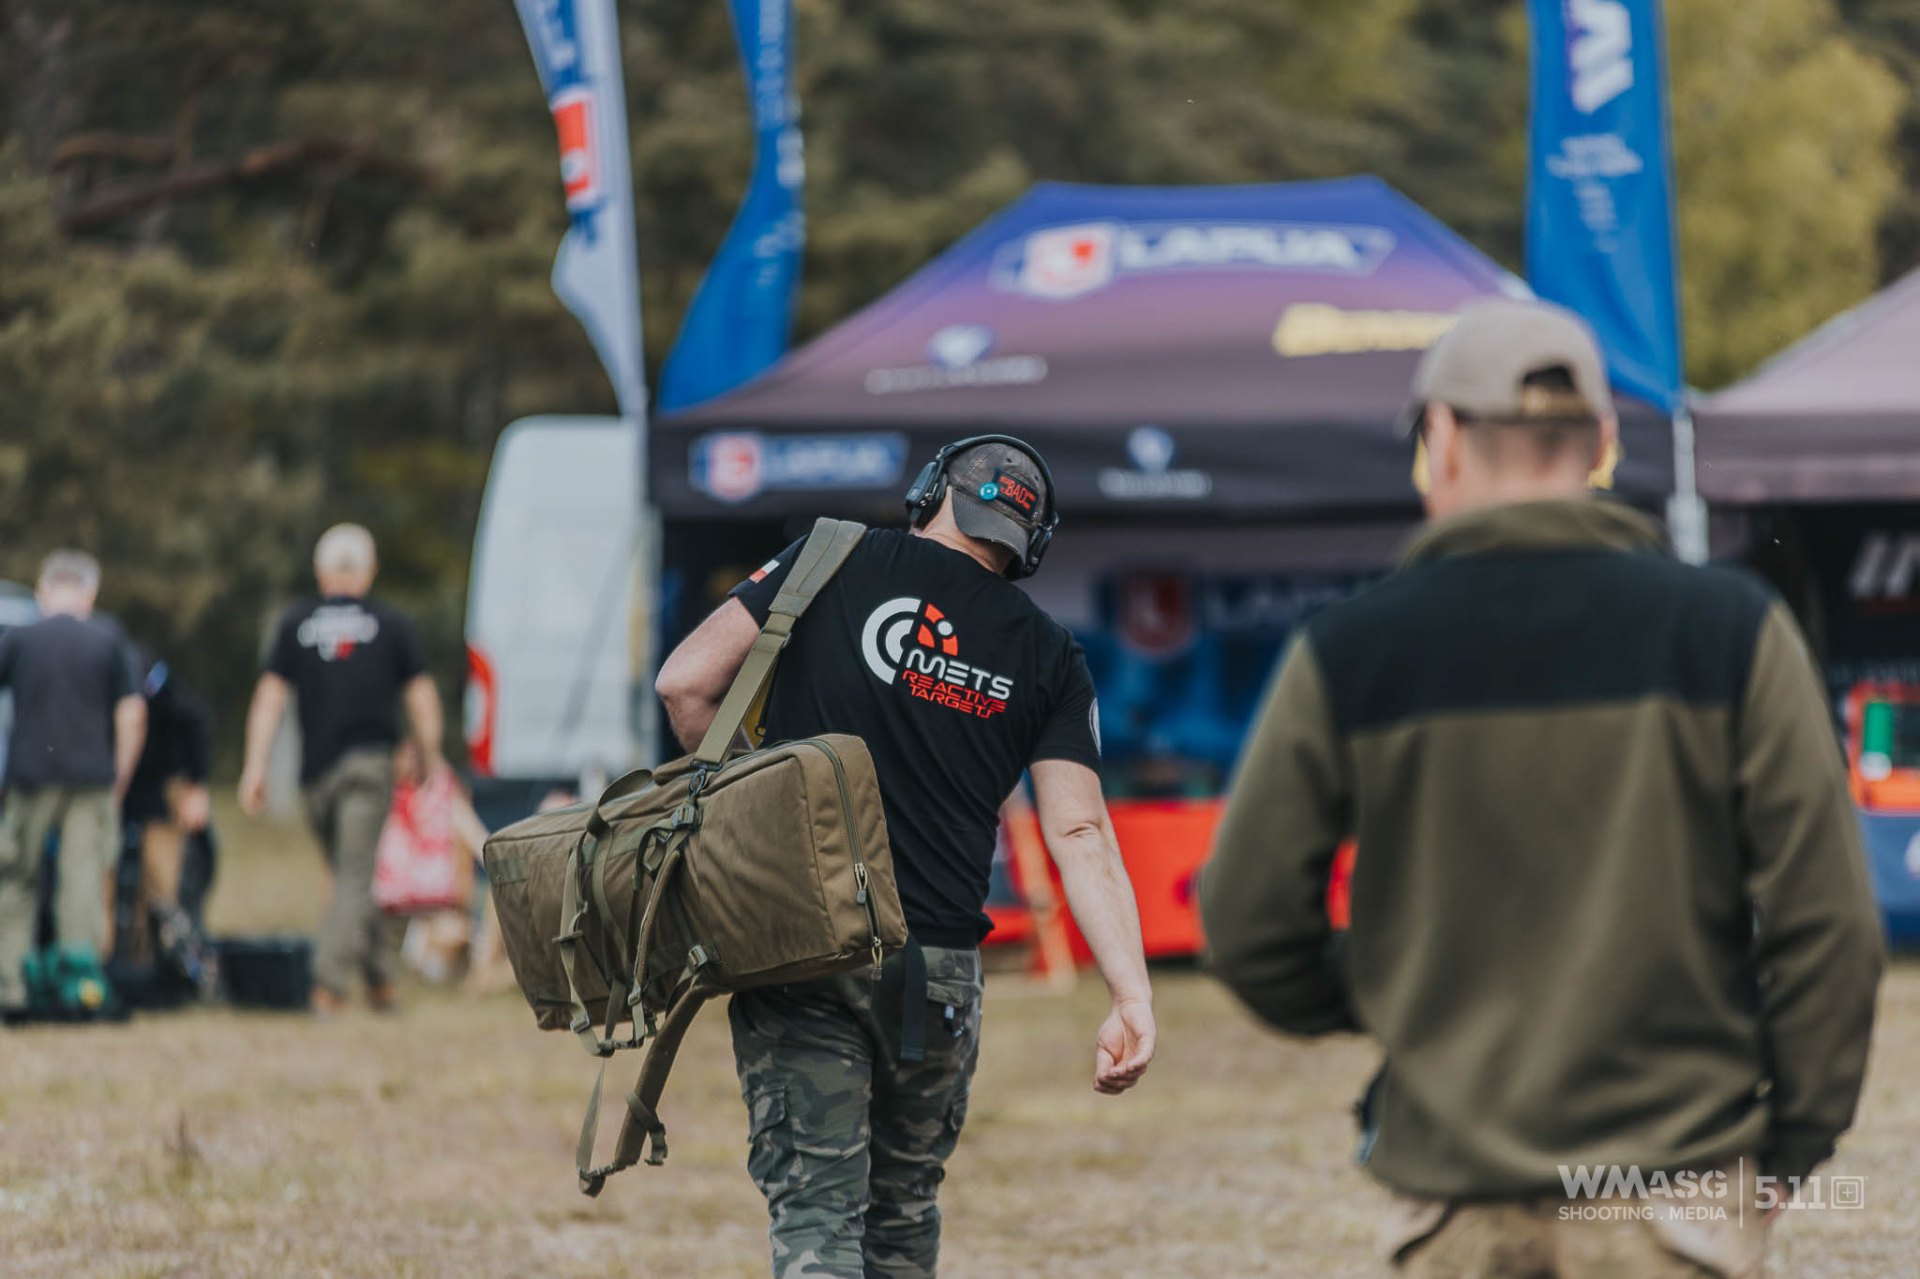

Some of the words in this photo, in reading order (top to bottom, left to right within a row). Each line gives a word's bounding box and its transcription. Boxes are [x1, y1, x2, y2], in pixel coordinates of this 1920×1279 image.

[902, 670, 1007, 713] REACTIVE
[906, 649, 1014, 700] METS
[909, 683, 993, 719] TARGETS
